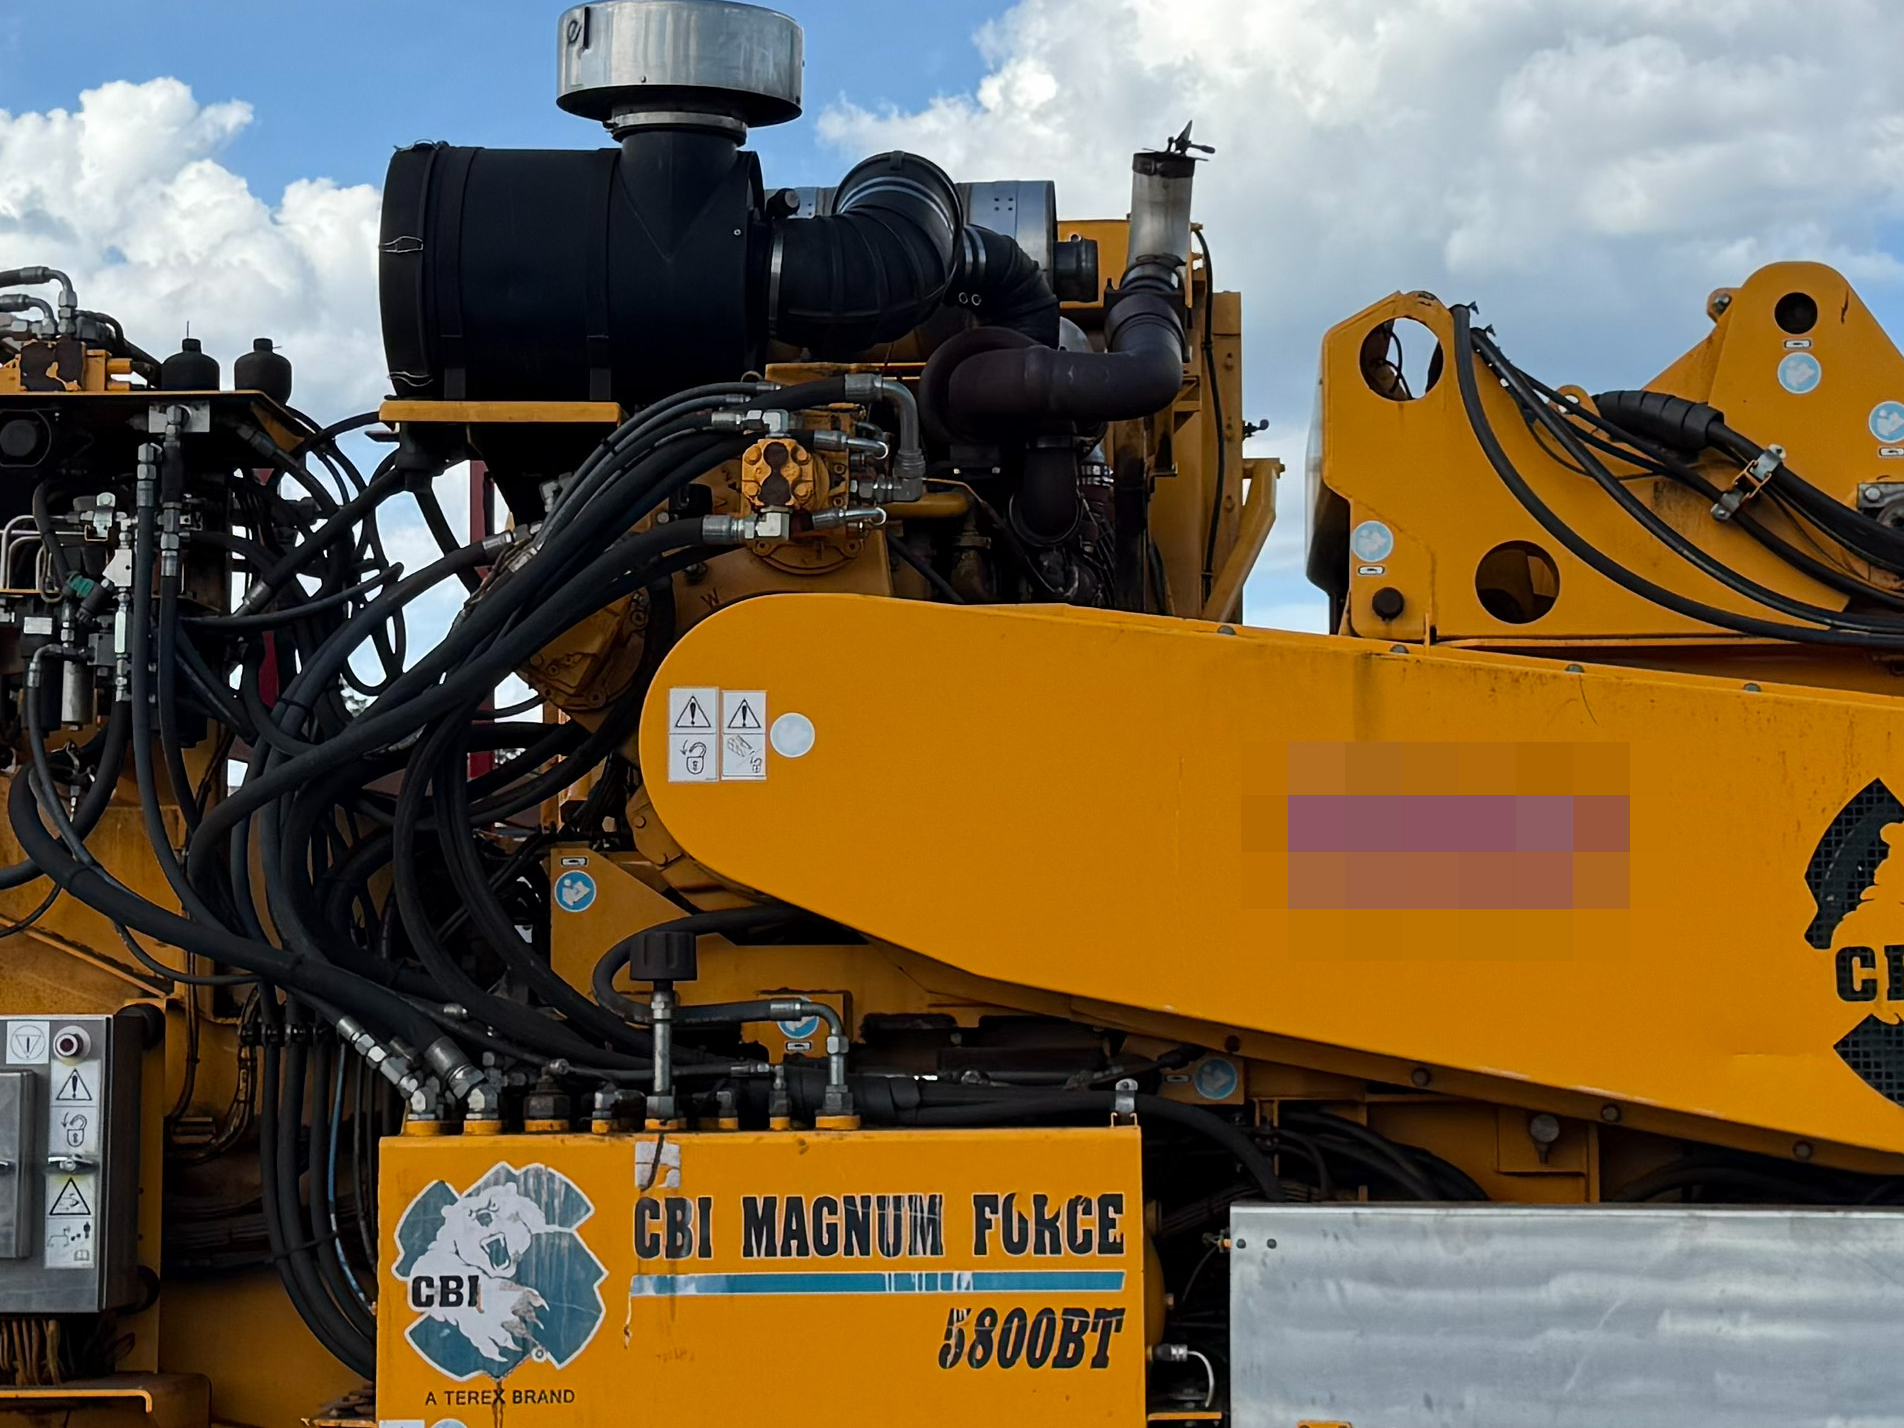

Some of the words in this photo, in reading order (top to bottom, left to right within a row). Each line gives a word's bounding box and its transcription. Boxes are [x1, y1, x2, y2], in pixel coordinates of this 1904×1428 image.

[634, 1195, 713, 1260] CBI
[742, 1193, 944, 1259] MAGNUM
[972, 1192, 1125, 1256] FORCE
[411, 1275, 480, 1308] CBI
[938, 1307, 1126, 1370] 5800BT
[425, 1391, 437, 1406] A
[444, 1389, 506, 1406] TEREX
[512, 1389, 575, 1404] BRAND
